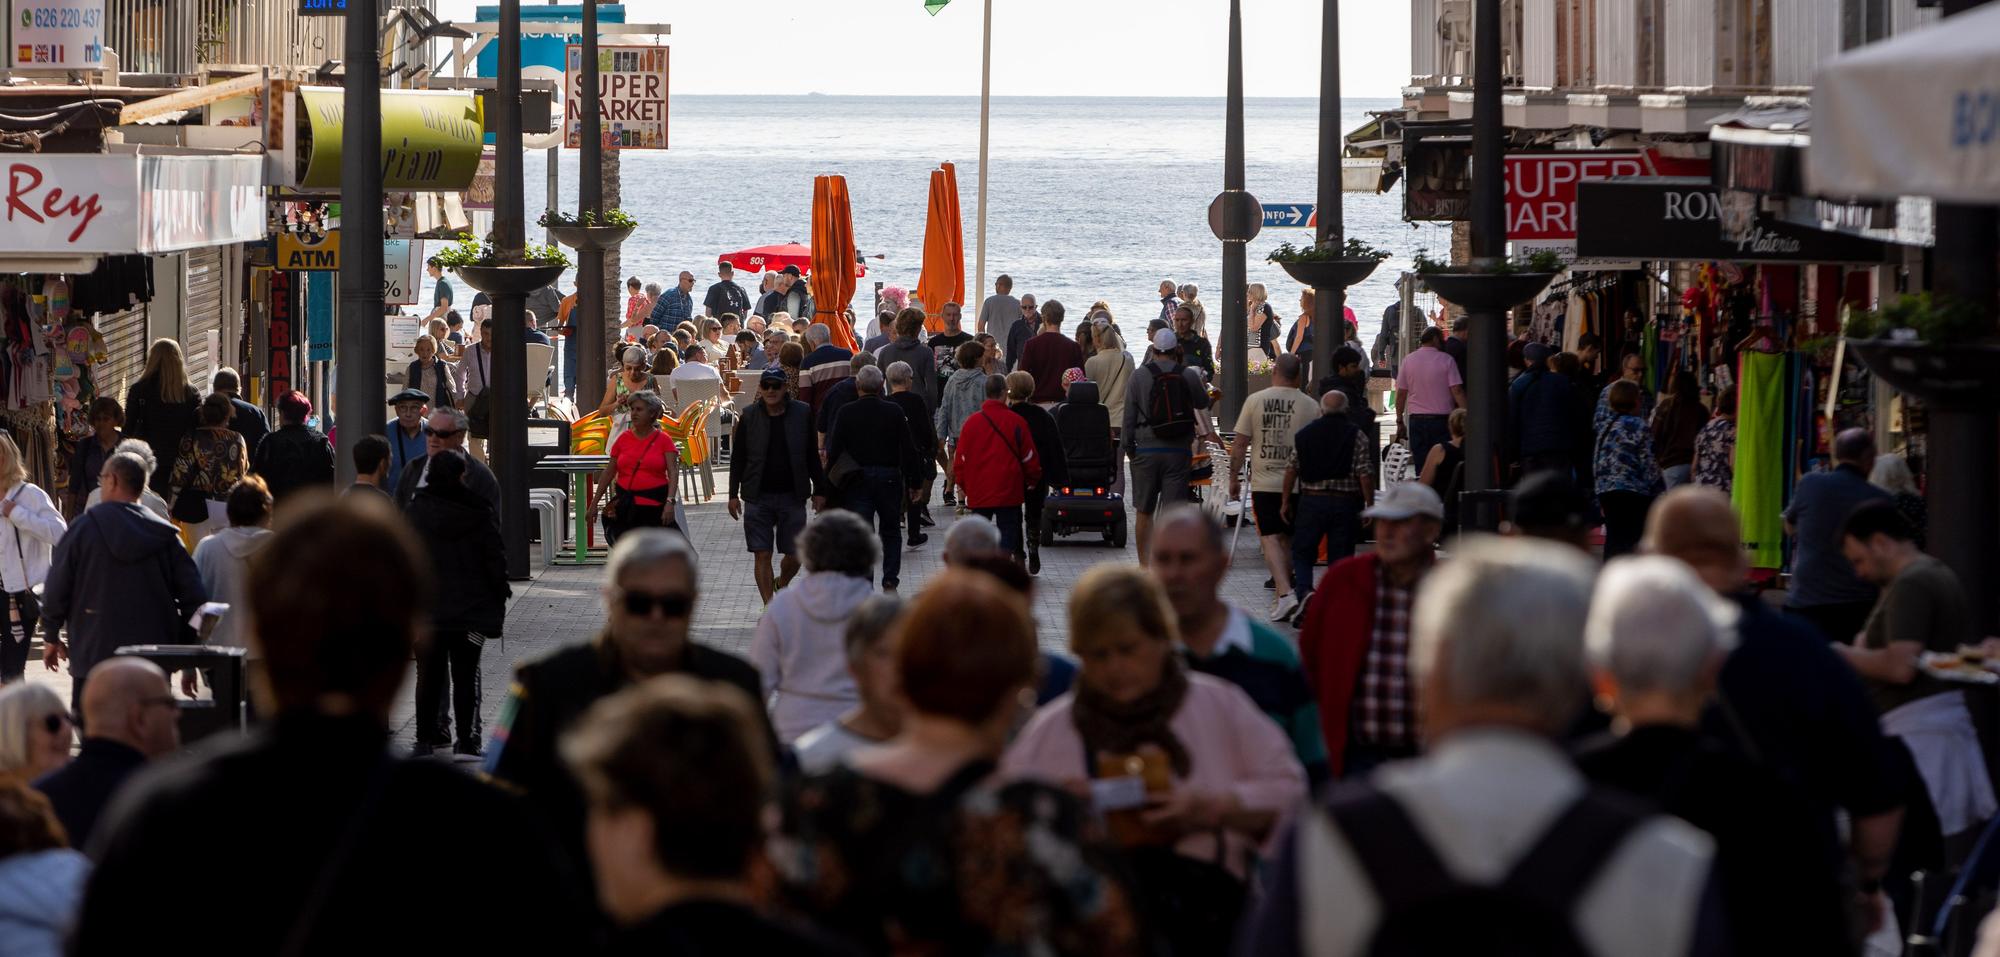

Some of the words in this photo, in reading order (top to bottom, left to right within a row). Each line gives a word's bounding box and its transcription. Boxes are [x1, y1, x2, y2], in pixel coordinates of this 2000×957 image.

[35, 8, 57, 28] 626
[60, 8, 80, 28] 220
[83, 8, 101, 28] 437
[85, 34, 102, 63] mb
[6, 163, 102, 243] Rey
[288, 250, 335, 267] ATM
[750, 256, 765, 265] SOS
[1263, 398, 1296, 414] WALK
[1261, 413, 1292, 429] WITH
[1260, 429, 1284, 444] THE
